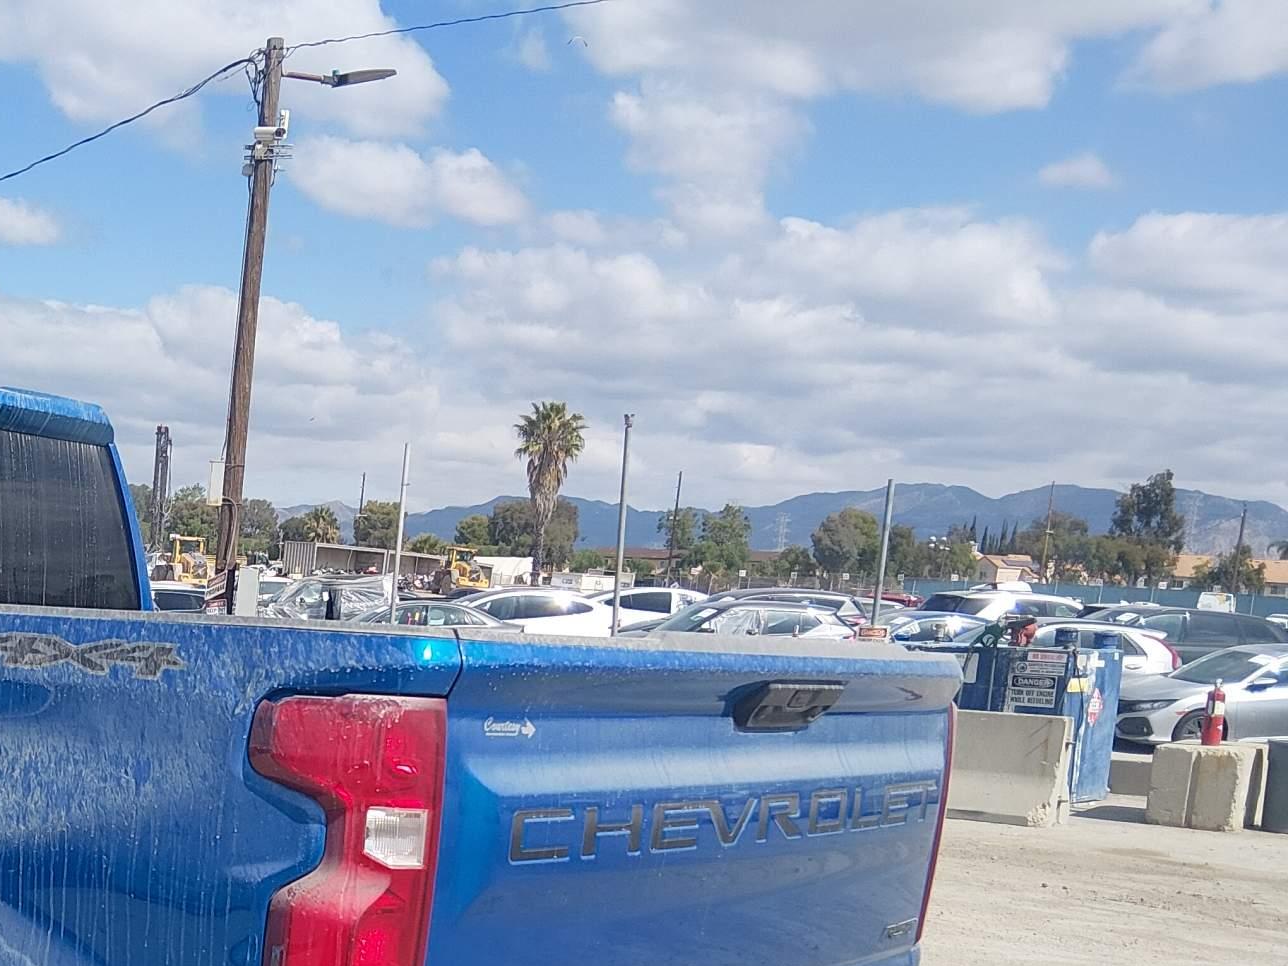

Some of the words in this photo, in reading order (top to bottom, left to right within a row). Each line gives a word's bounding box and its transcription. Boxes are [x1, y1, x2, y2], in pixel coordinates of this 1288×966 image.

[1018, 678, 1051, 687] DANGER
[1012, 688, 1024, 696] TURN
[1026, 689, 1035, 697] OFF
[1036, 690, 1054, 698] ENGINE
[1010, 696, 1025, 704] WHILE
[484, 716, 520, 736] Courtesy
[508, 781, 937, 866] CHEVROLET
